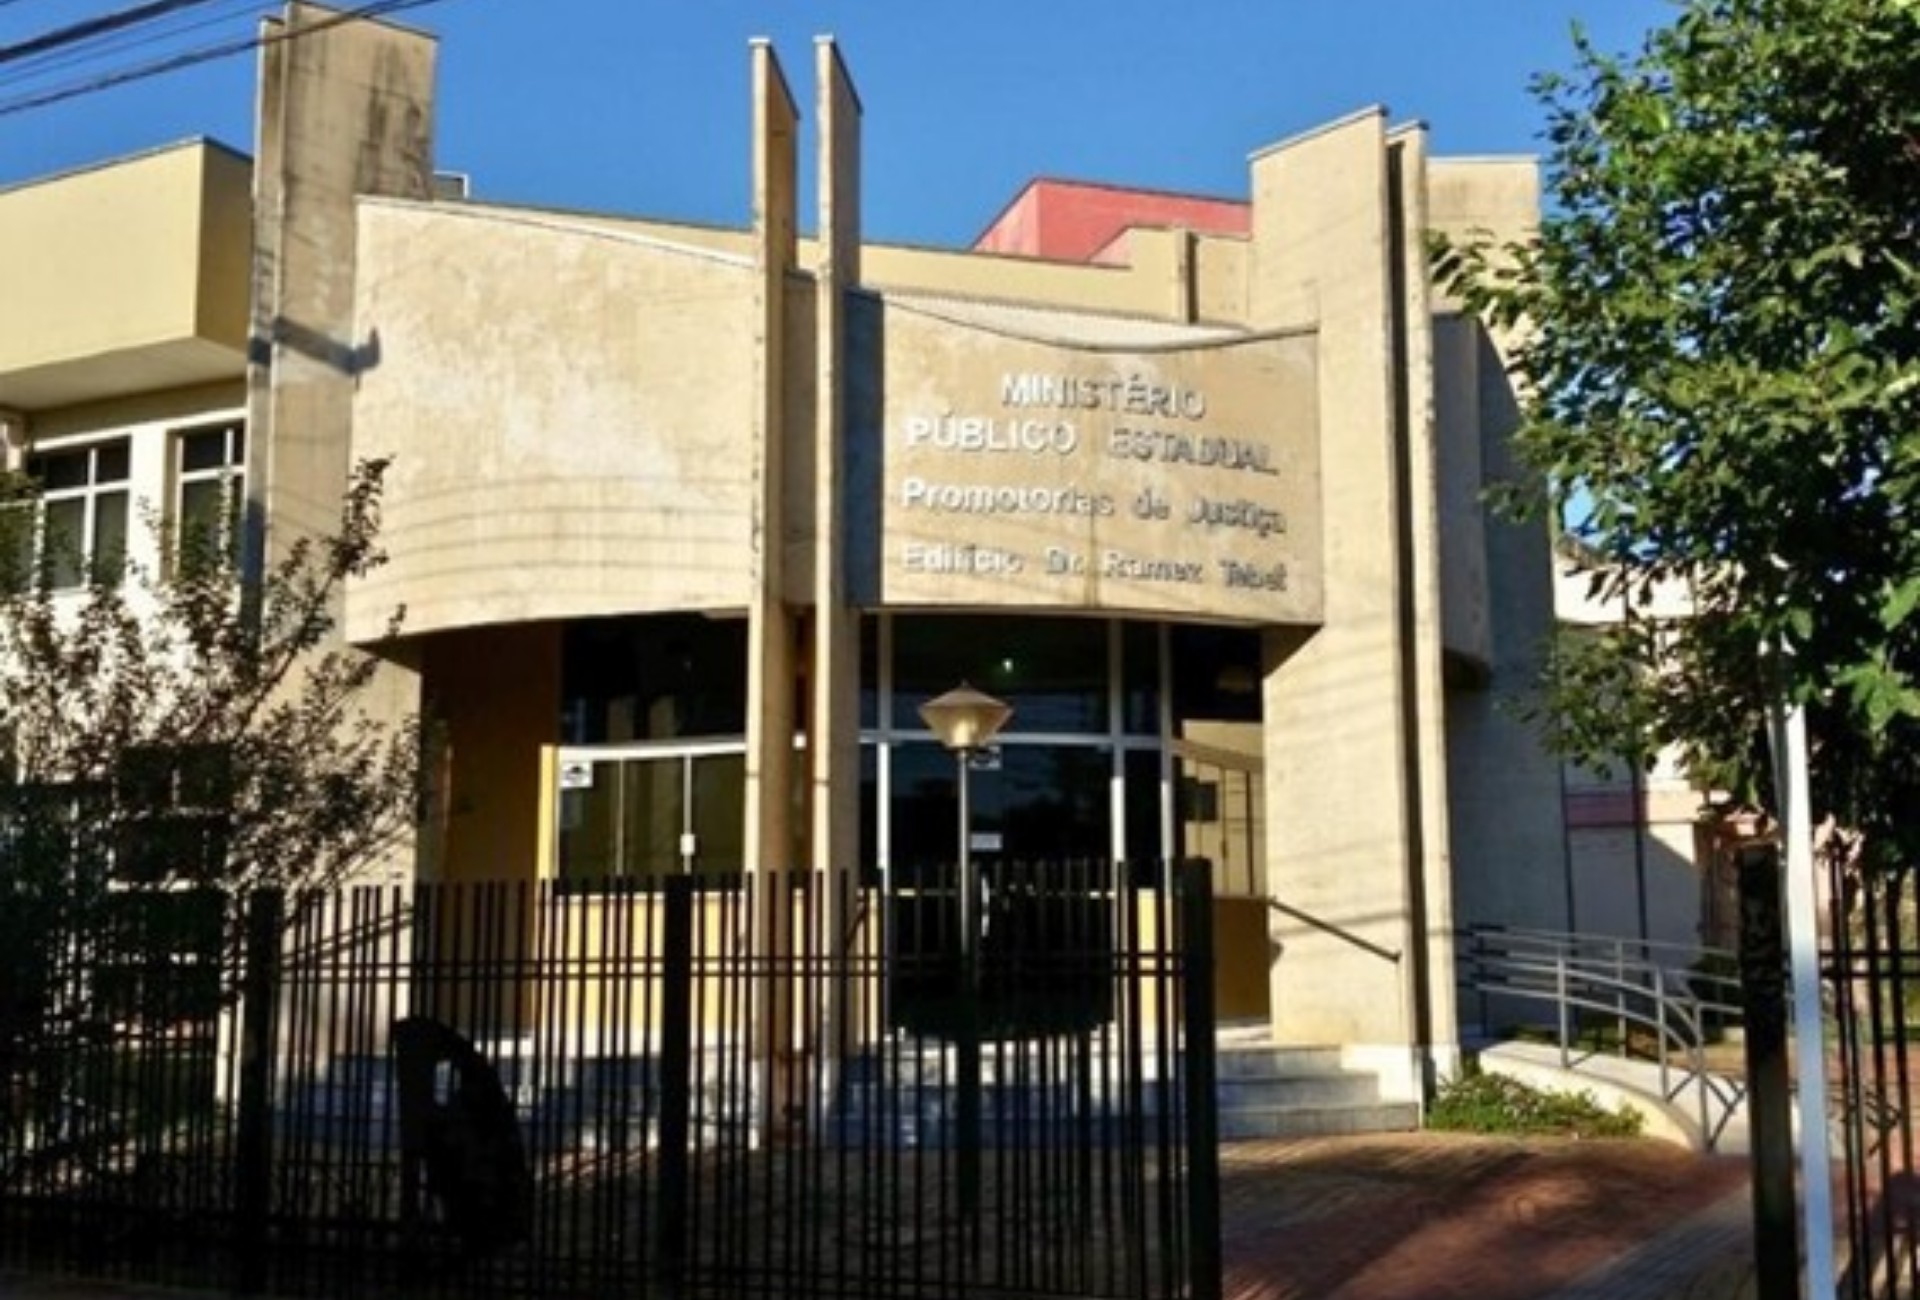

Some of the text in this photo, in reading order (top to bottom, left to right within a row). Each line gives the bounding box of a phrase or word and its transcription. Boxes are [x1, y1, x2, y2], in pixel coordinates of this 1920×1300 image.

[1002, 373, 1206, 420] MINISTÉRIO
[905, 408, 1279, 476] PÚBLICO ESTADUAL
[903, 476, 1115, 517] Promotorias
[1132, 486, 1172, 520] de
